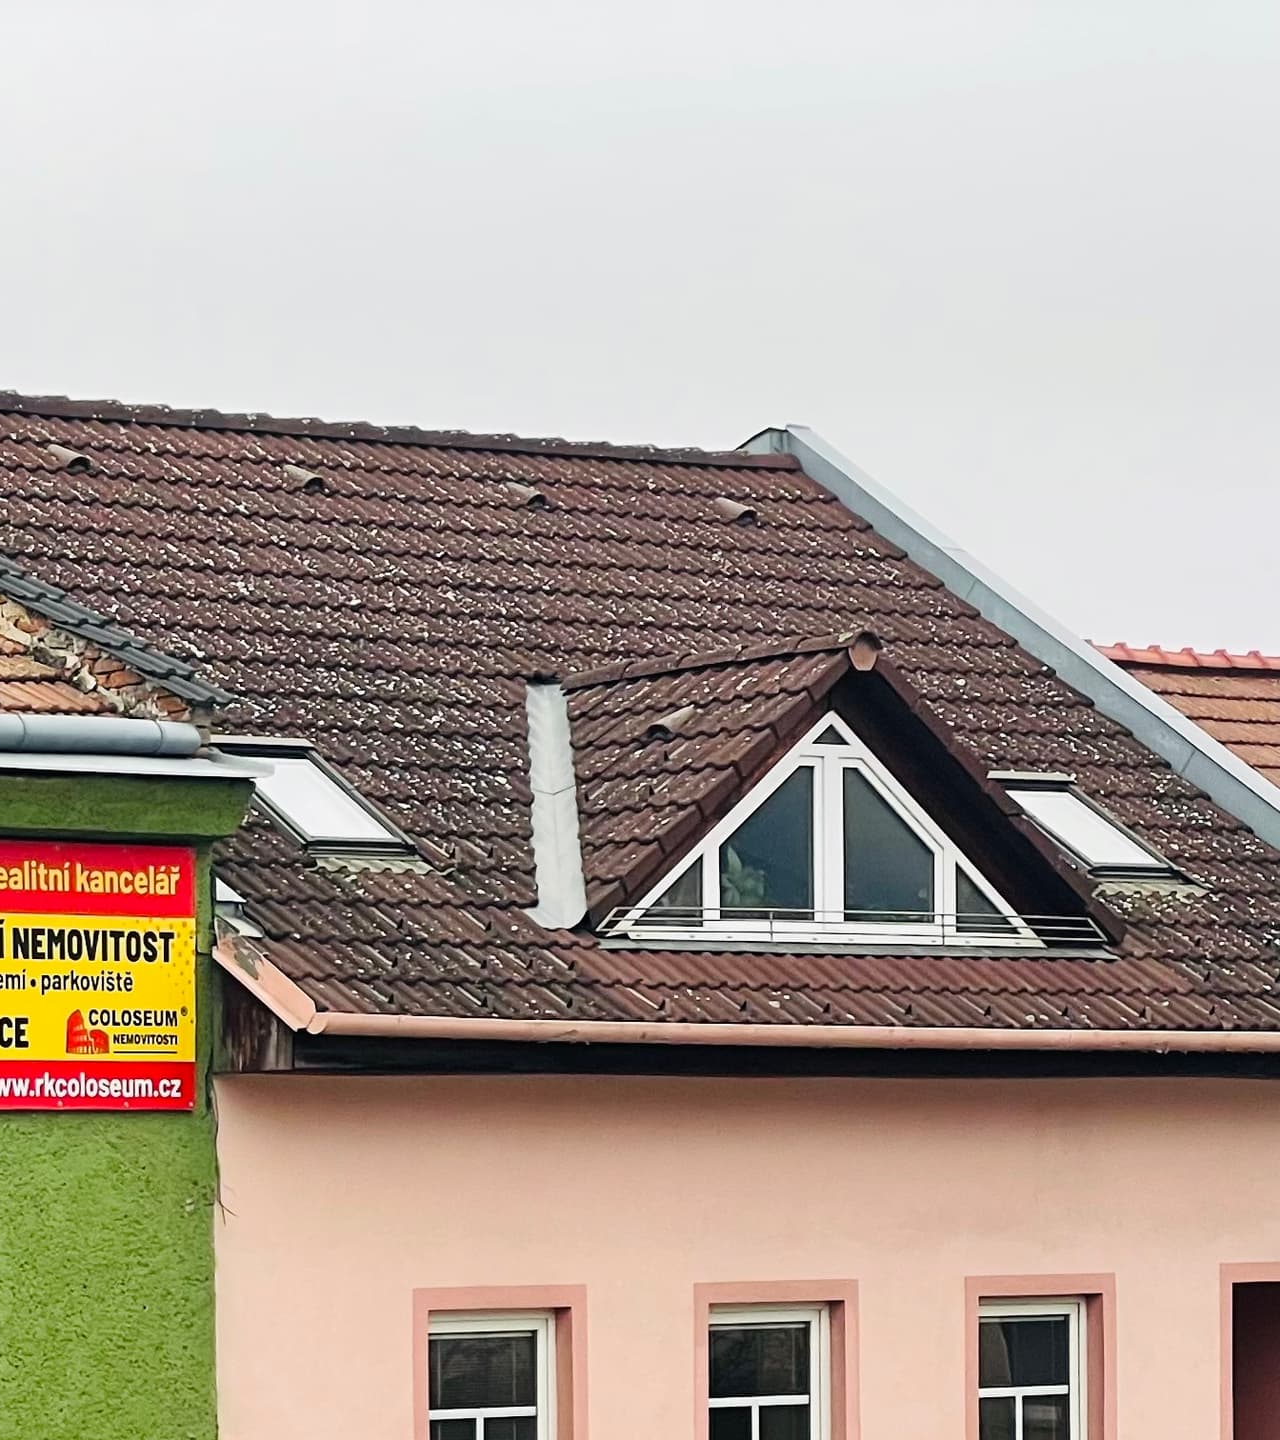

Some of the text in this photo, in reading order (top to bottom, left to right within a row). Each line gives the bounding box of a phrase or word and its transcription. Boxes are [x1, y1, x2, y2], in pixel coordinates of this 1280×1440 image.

[75, 862, 181, 896] kancelář
[12, 927, 176, 963] NEMOVITOST
[41, 968, 134, 995] parkoviště
[88, 1009, 178, 1027] COLOSEUM
[112, 1033, 178, 1046] NEMOVITOSTI
